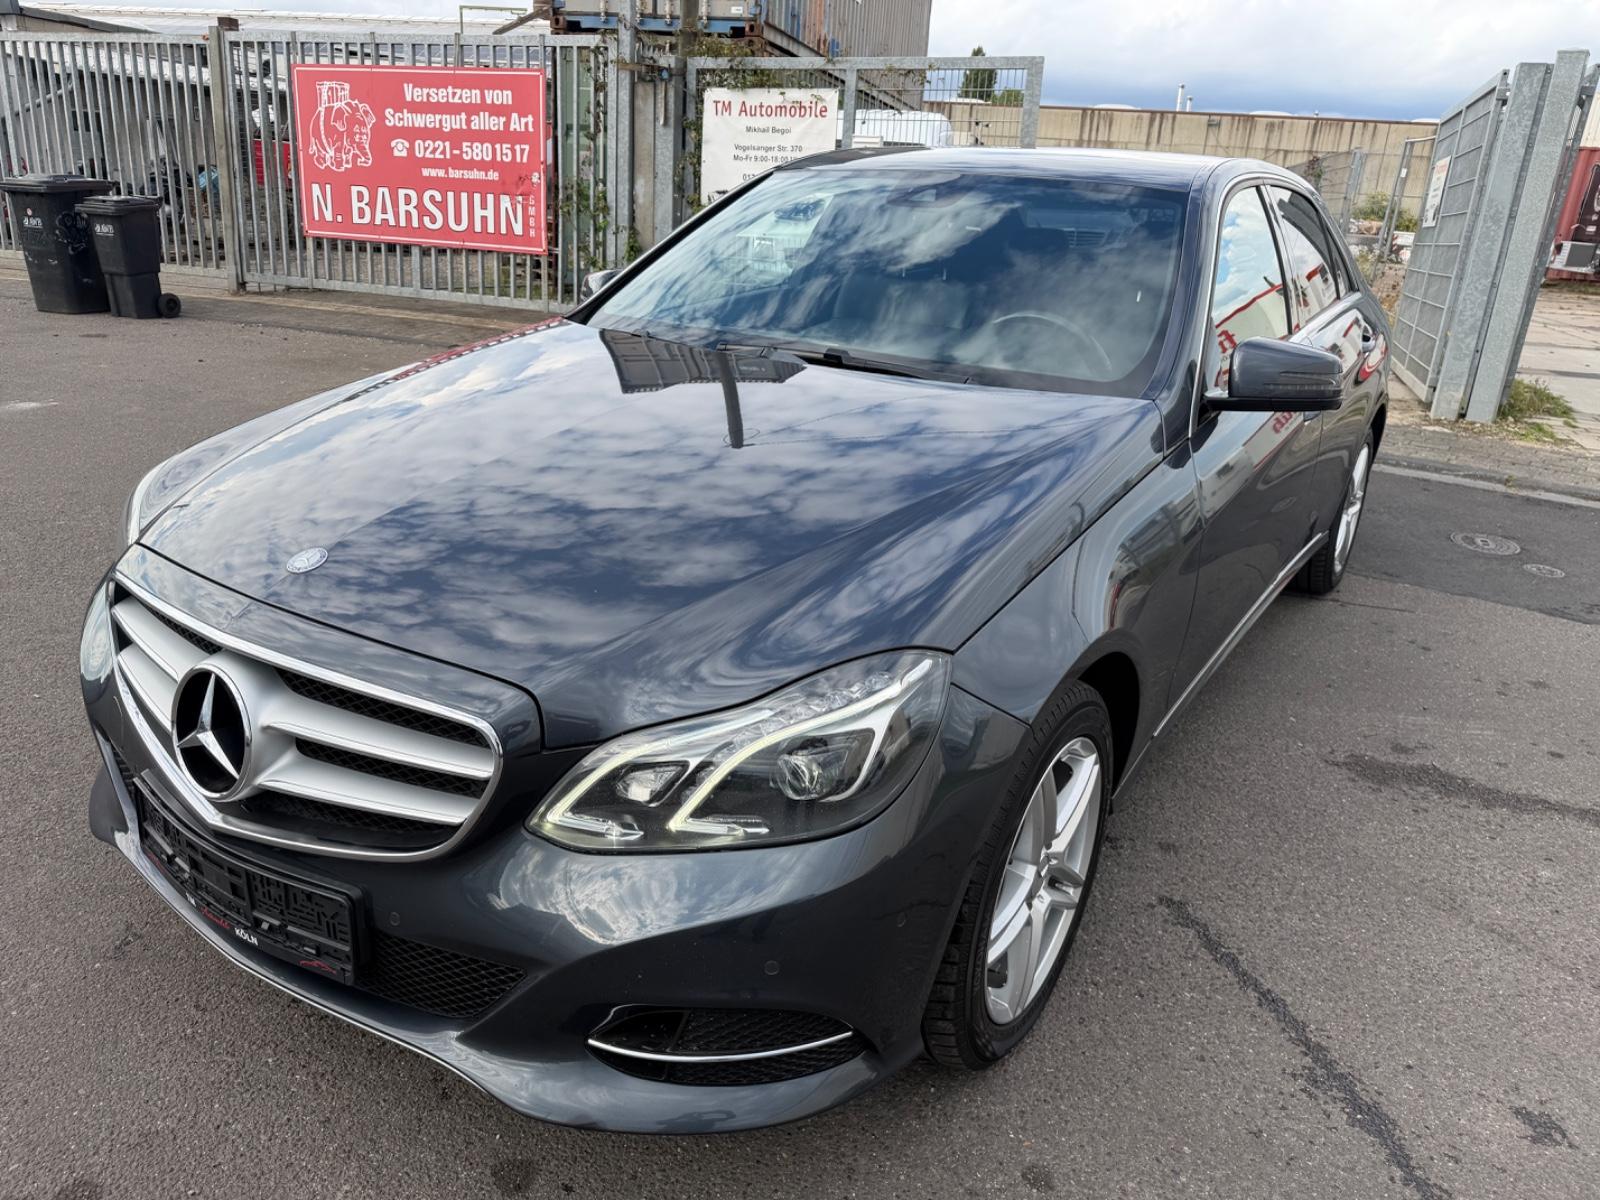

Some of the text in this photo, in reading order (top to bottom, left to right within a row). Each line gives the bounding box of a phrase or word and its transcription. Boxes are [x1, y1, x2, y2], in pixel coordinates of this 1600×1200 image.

[403, 83, 512, 105] Versetzen von
[713, 100, 828, 118] TM Automobile
[384, 107, 534, 132] Schwergut aller Art
[745, 126, 770, 134] Mikhail
[733, 153, 753, 161] Mo-Fr
[421, 166, 500, 181] www.barsuhn.de
[310, 183, 524, 236] N. BARSUHN
